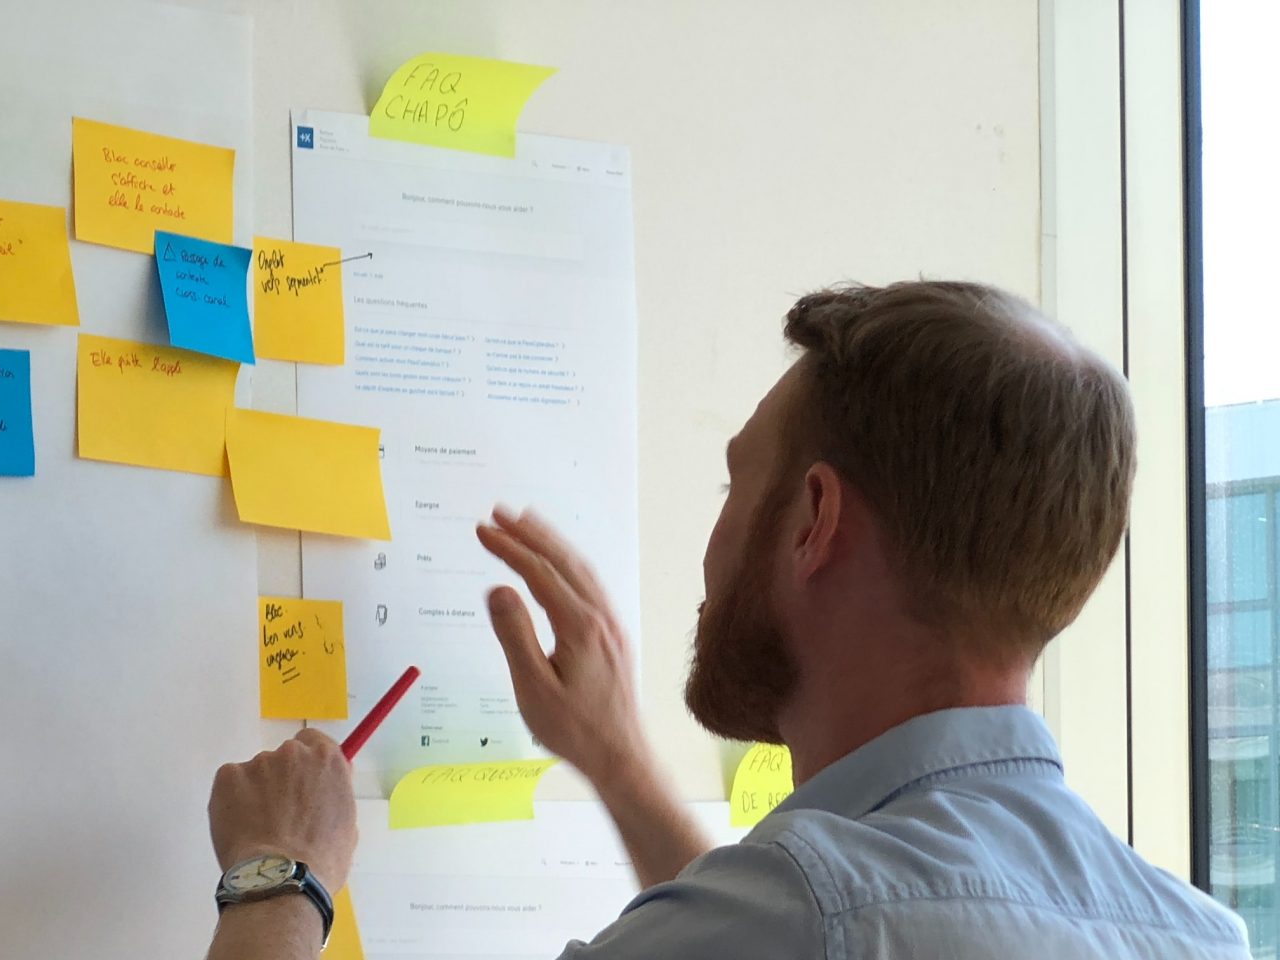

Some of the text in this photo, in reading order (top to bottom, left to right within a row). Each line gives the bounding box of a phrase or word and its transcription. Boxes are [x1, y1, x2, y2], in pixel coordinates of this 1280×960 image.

[404, 63, 462, 94] FAQ
[385, 94, 468, 131] CHAPÔ
[162, 183, 176, 197] et
[742, 790, 758, 814] DE
